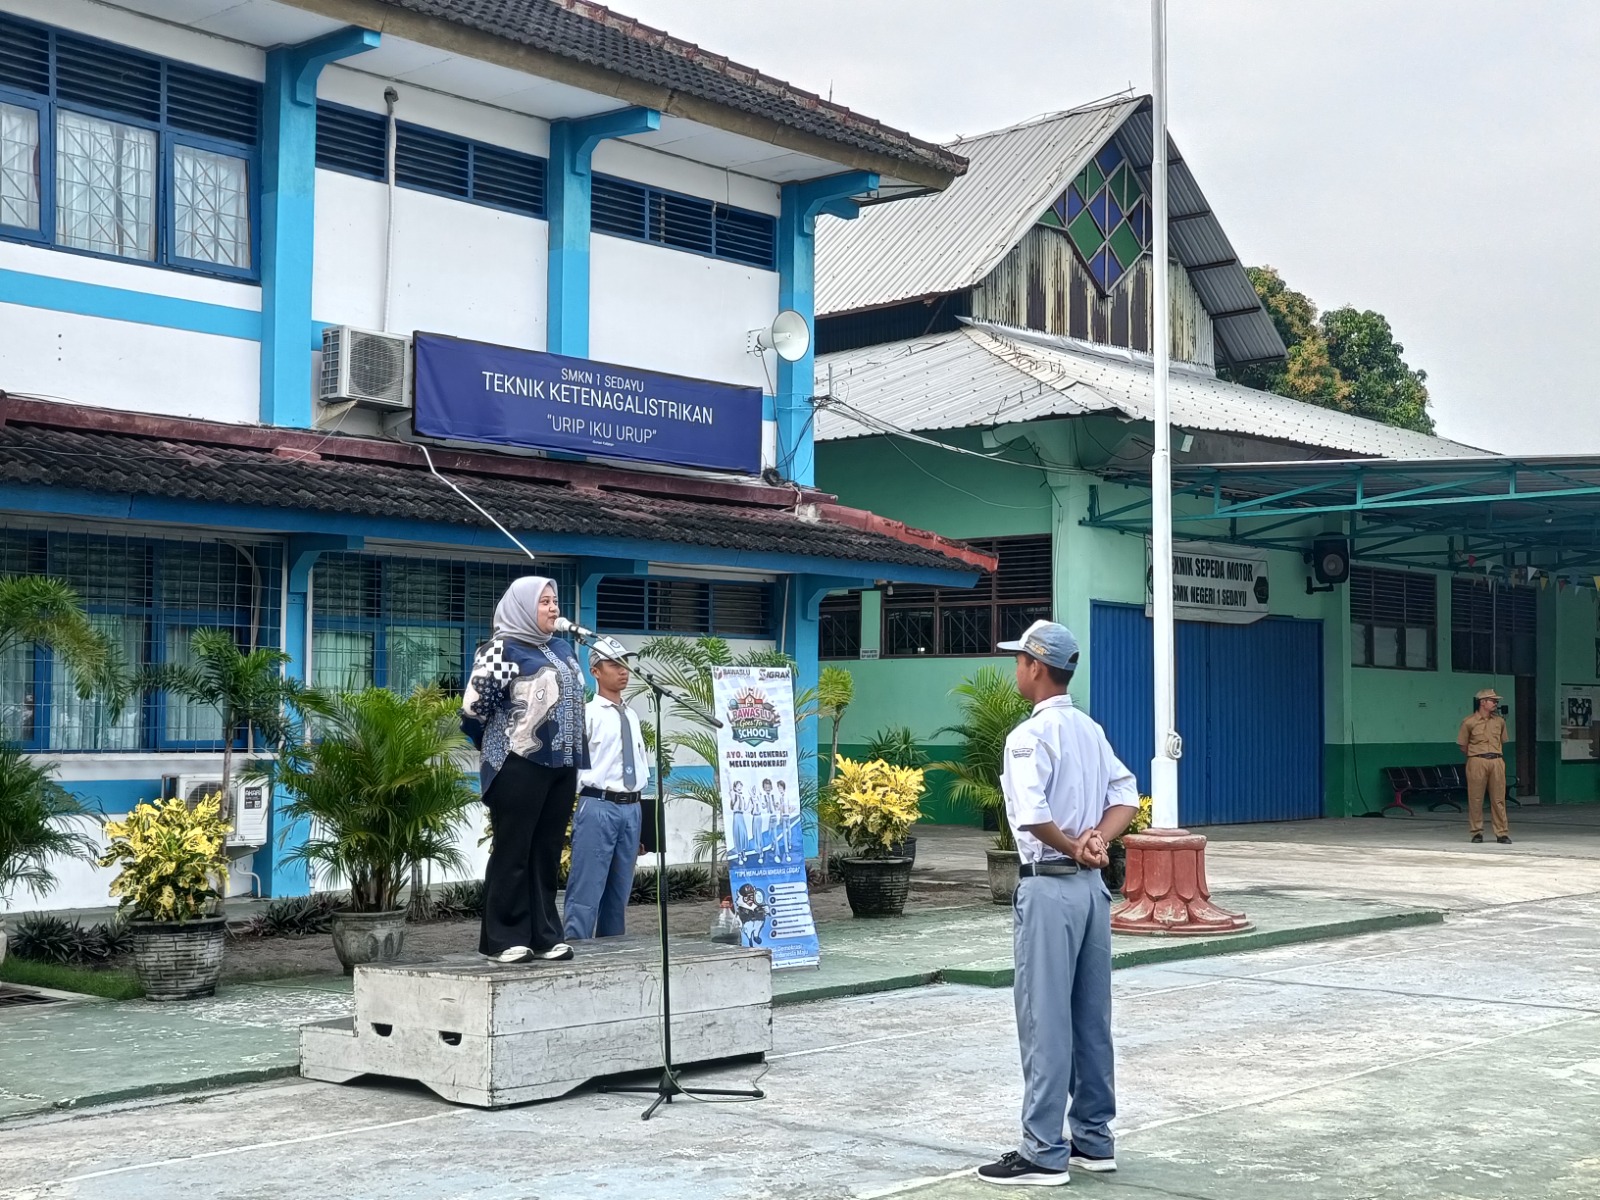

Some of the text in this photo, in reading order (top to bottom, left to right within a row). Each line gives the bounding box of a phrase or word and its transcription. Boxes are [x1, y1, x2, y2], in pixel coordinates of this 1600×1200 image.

[561, 368, 645, 393] SMKN 1 SEDAYU
[482, 371, 714, 425] TEKNIK KETENAGALISTRIKAN
[547, 413, 658, 444] "URIP IKU URUP"
[1195, 558, 1225, 580] SEPEDA
[1227, 561, 1254, 582] MOTOR
[1190, 586, 1216, 605] NEGERI
[1217, 589, 1221, 605] 1
[1222, 589, 1247, 607] SEDAYU
[732, 708, 772, 721] BAWASLU
[738, 728, 772, 739] SCHOOL
